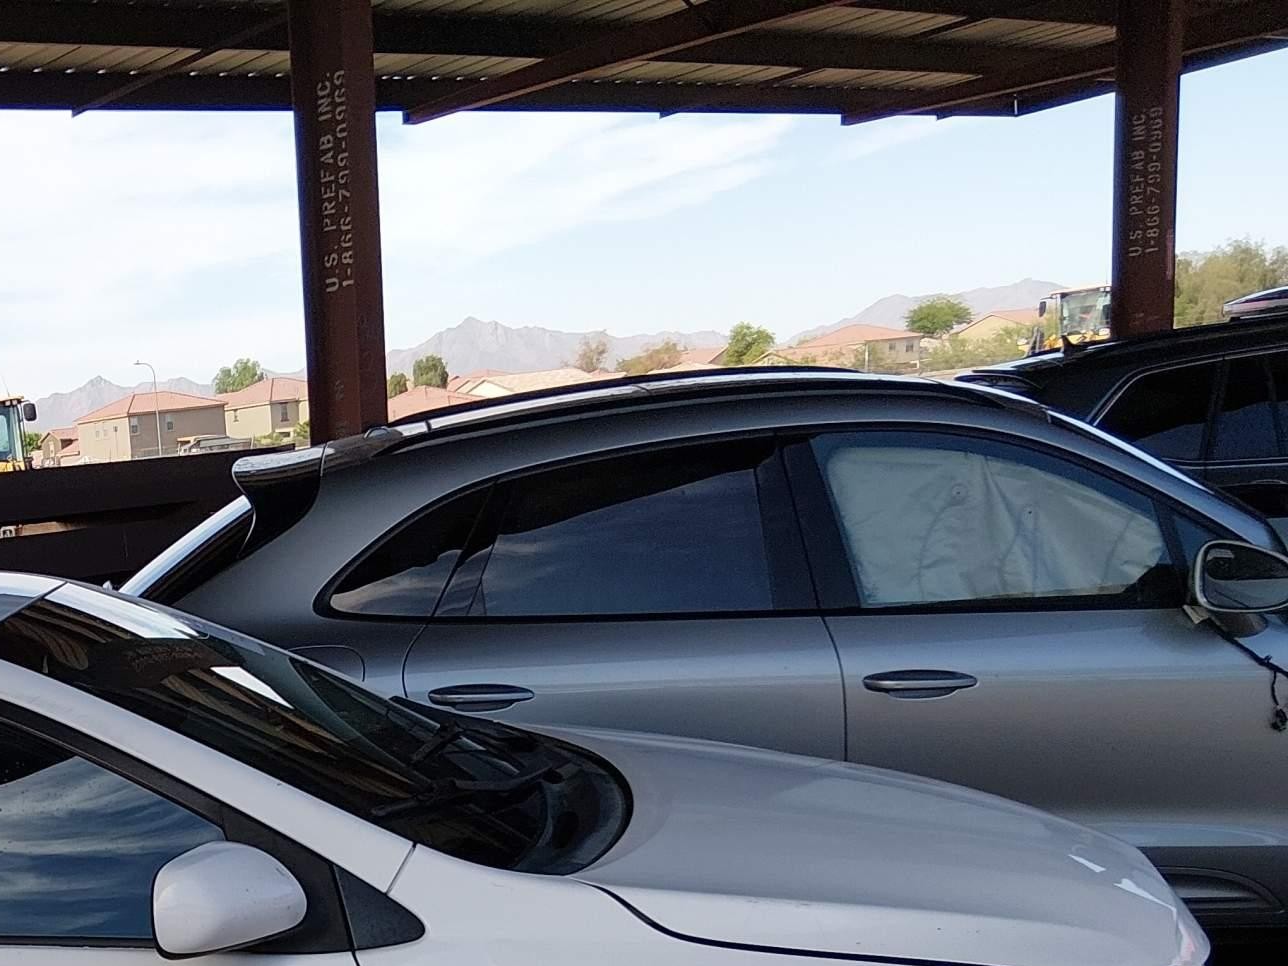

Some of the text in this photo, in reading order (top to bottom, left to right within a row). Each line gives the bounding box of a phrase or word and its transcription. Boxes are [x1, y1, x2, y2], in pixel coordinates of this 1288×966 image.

[316, 72, 340, 293] U.S. PREFAB INC.
[1129, 150, 1145, 216] PREFAB
[1128, 225, 1143, 257] U.S.
